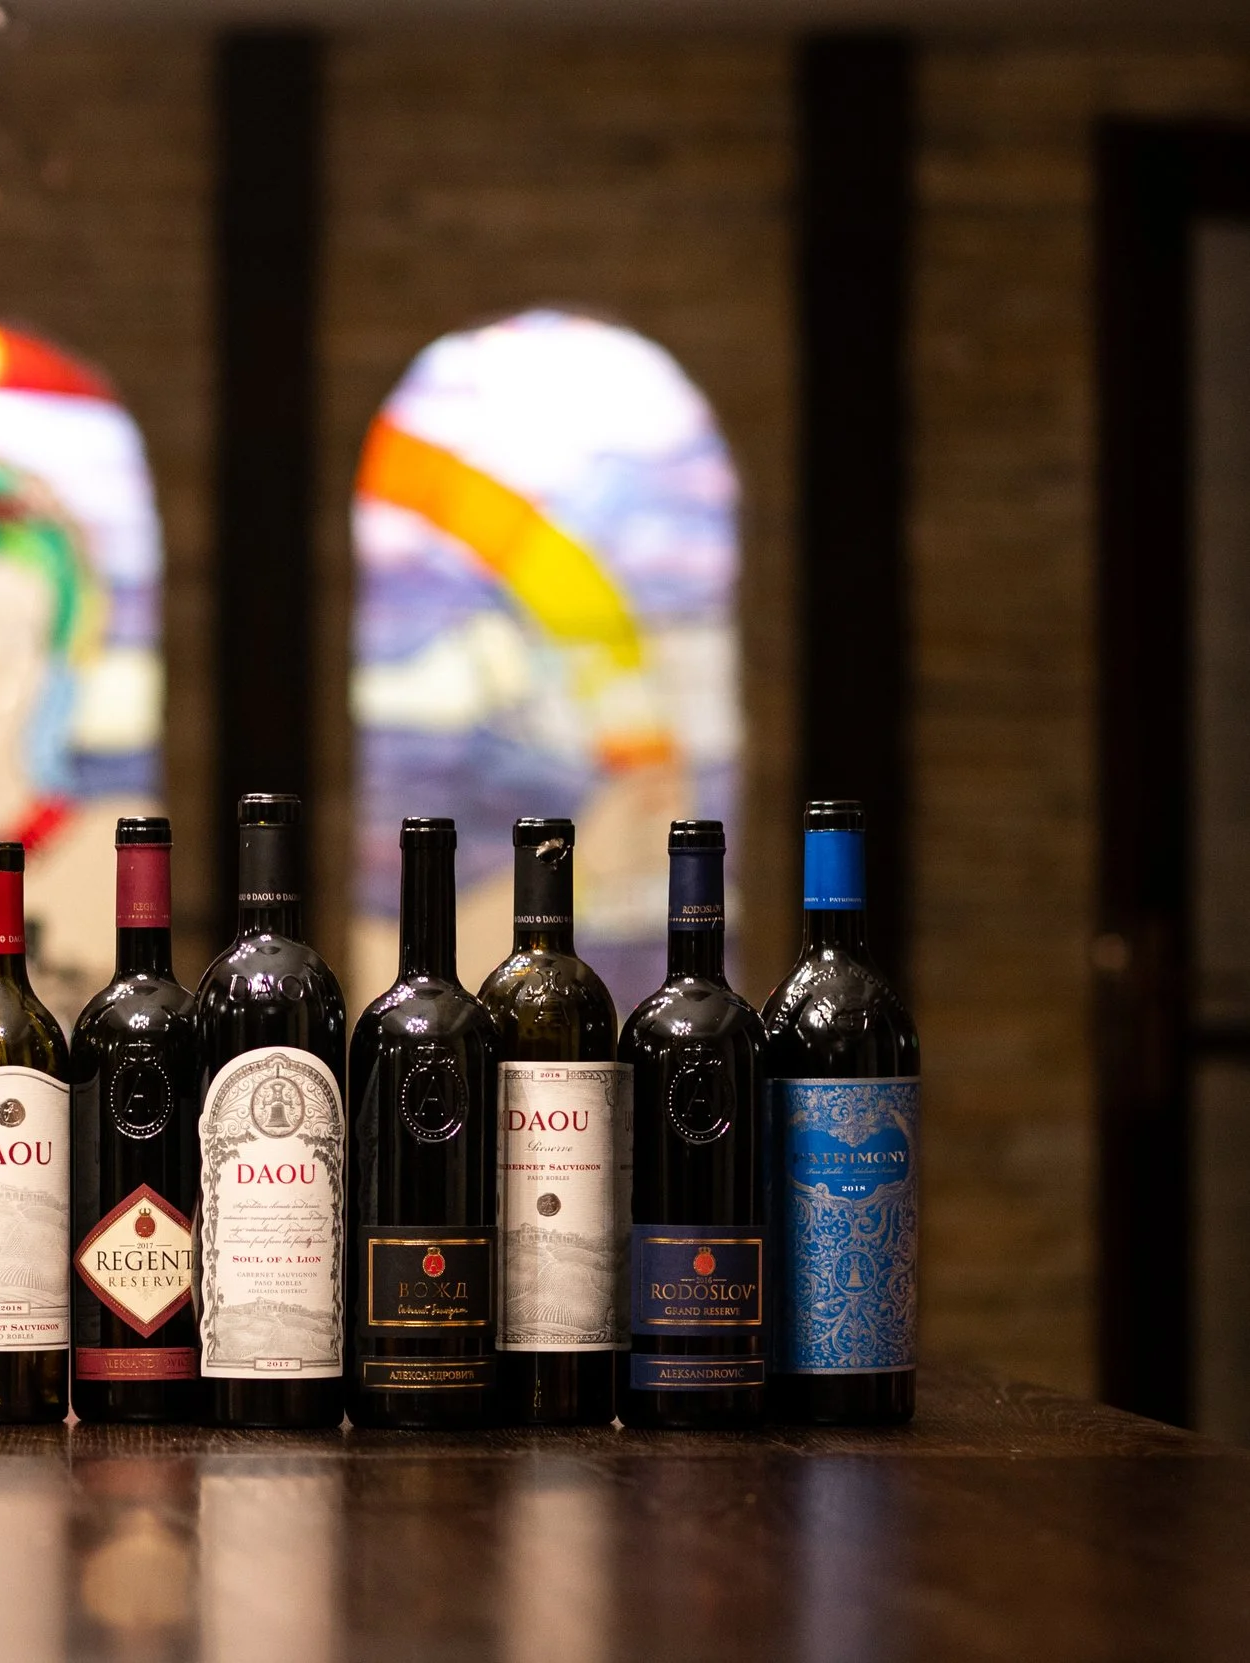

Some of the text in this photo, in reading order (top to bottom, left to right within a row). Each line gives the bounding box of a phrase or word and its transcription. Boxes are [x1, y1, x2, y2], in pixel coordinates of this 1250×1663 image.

[252, 893, 275, 901] DAOU
[282, 893, 298, 901] DAO
[682, 904, 722, 914] RODOSLOV
[543, 915, 564, 924] DAOU
[507, 1110, 589, 1132] DAOU
[524, 1139, 574, 1153] Reserve
[794, 1150, 907, 1165] ATRIMONY
[550, 1162, 602, 1171] SAUVIGNON
[237, 1163, 316, 1185] DAOU
[136, 1242, 154, 1250] 2017
[96, 1250, 194, 1271] REGENT
[232, 1255, 263, 1263] SOUL
[297, 1255, 322, 1263] LION
[108, 1276, 185, 1288] RESERVE
[399, 1281, 469, 1300] ВОЖД
[650, 1283, 753, 1301] RODOSLOV
[664, 1306, 741, 1316] GRAND RESERVE
[10, 1323, 60, 1331] SAUVIGNON
[659, 1367, 746, 1379] ALEKSANDROVIĆ
